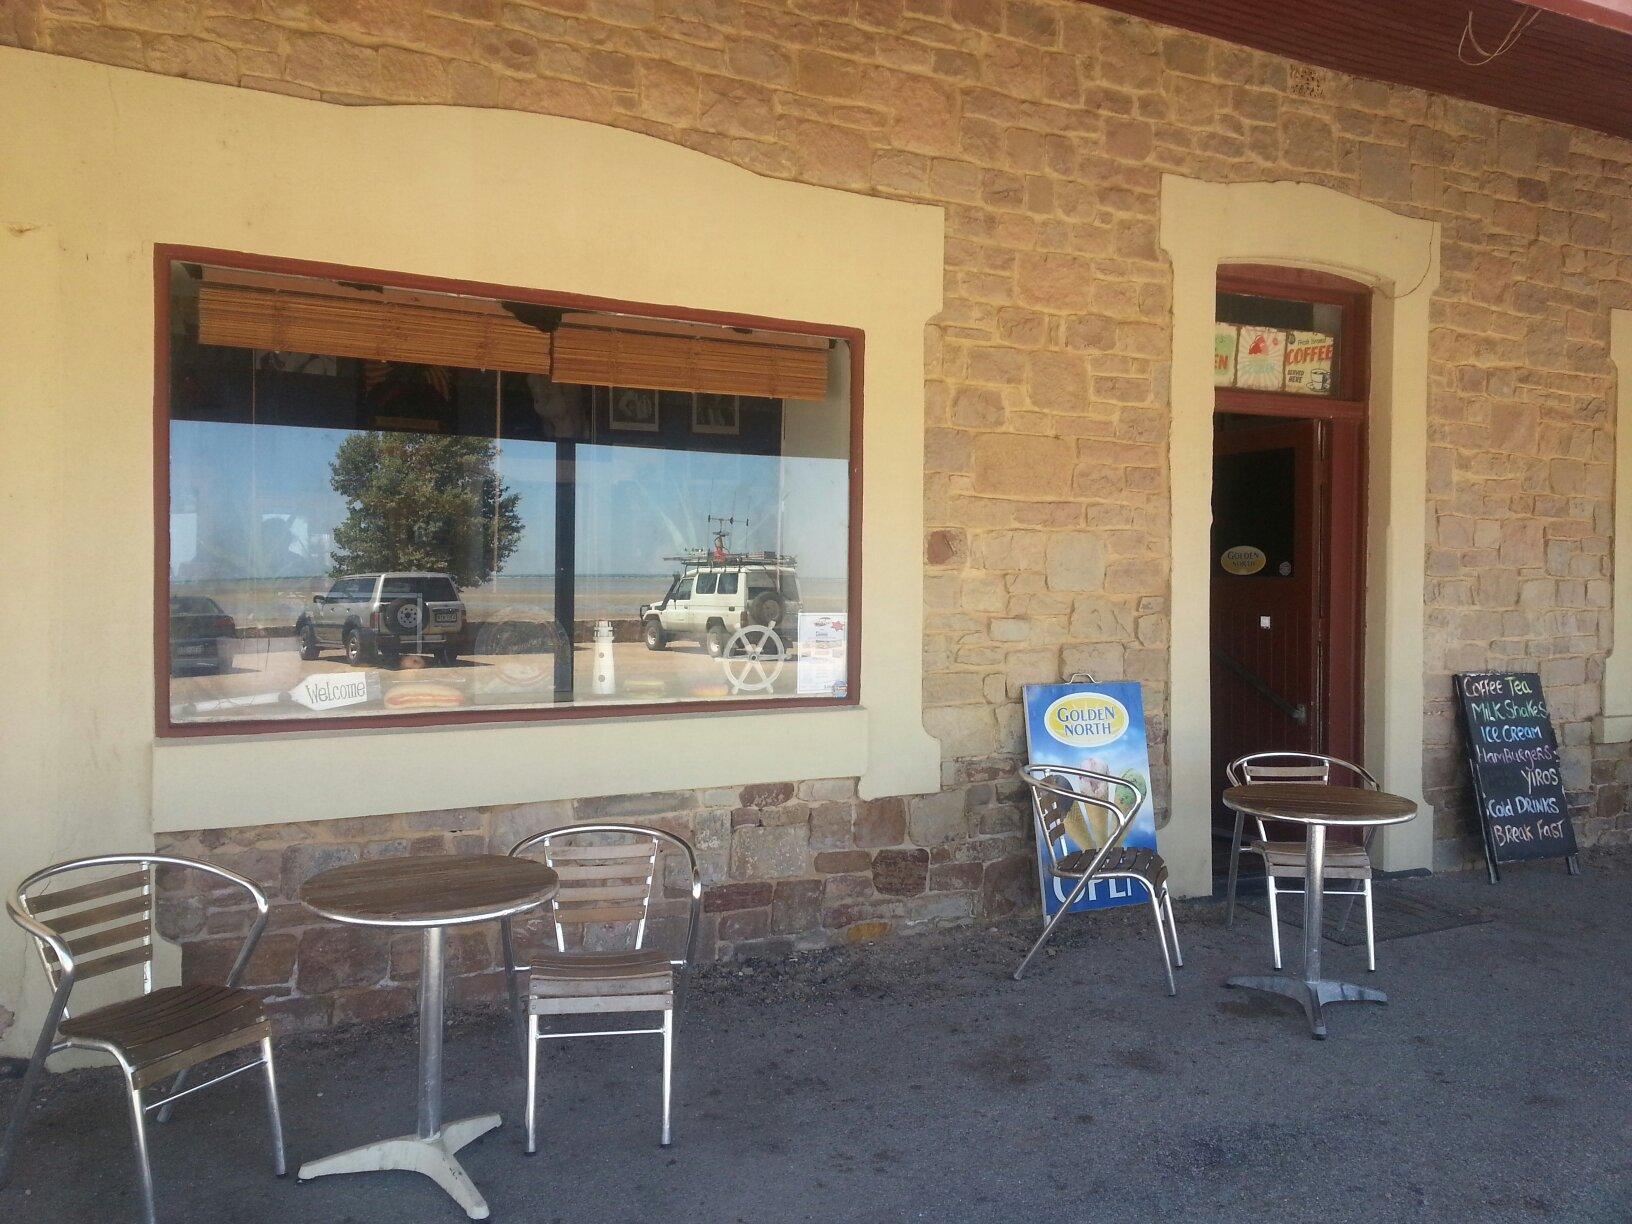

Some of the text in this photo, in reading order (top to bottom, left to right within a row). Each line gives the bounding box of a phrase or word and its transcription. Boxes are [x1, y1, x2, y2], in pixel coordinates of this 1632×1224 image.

[1286, 344, 1334, 365] COFFEE
[1227, 551, 1259, 560] GOLDEN
[1232, 560, 1255, 568] NORTH
[305, 681, 366, 704] Welcome
[1504, 676, 1533, 696] Tea
[1057, 706, 1116, 723] GOLDEN
[1064, 722, 1112, 736] NORTH
